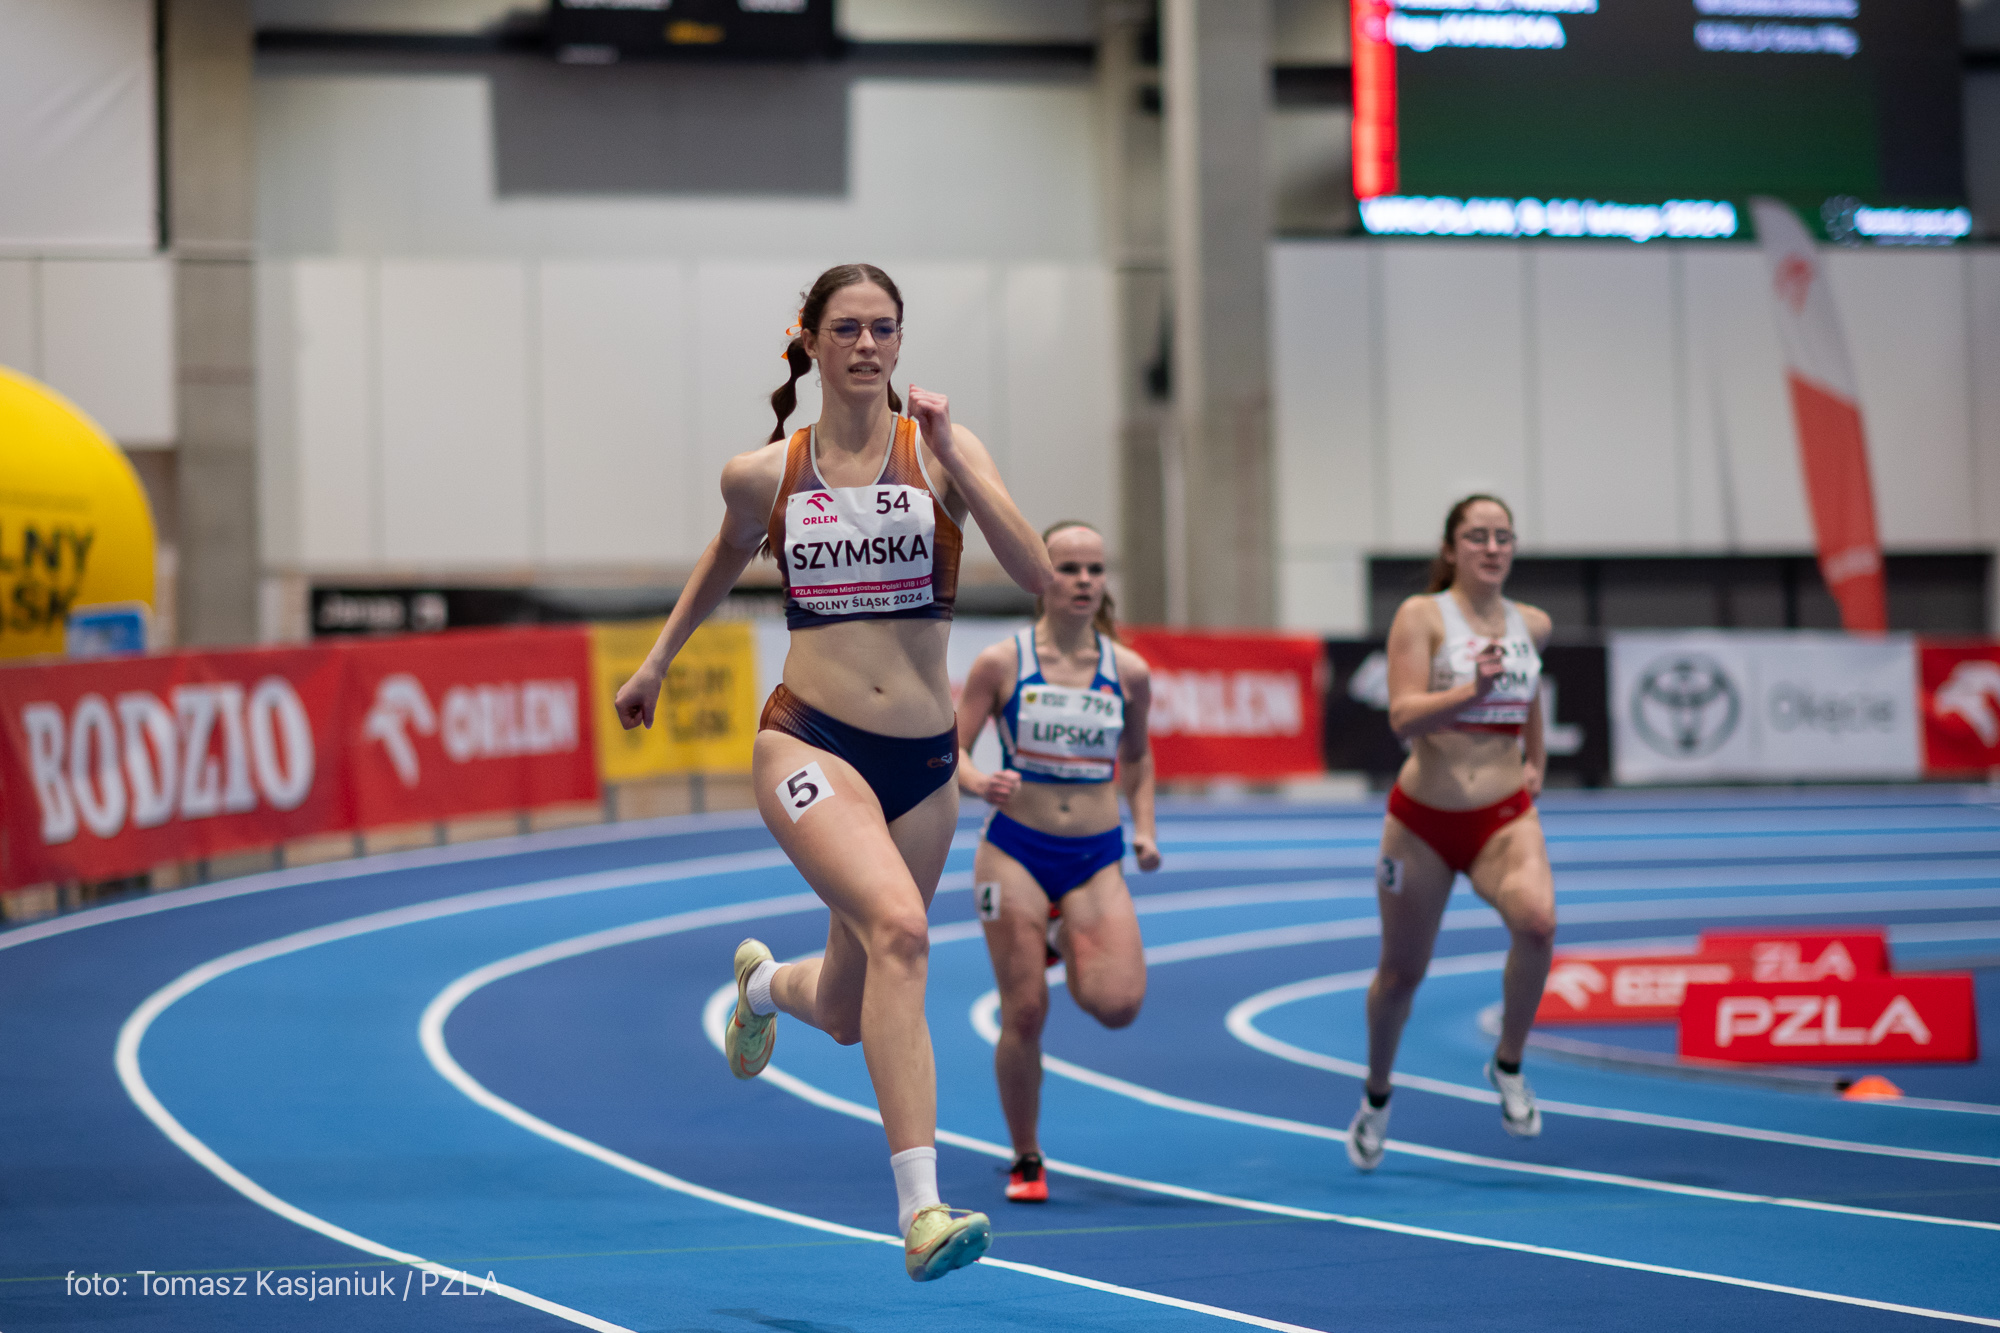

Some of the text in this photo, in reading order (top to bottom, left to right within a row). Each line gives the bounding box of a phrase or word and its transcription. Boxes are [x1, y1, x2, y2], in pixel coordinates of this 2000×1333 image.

[876, 491, 911, 514] 54
[803, 515, 838, 525] ORLEN
[792, 534, 929, 570] SZYMSKA
[795, 588, 812, 596] PZLA
[813, 587, 839, 595] Halowe
[839, 585, 881, 594] Mistrzostwa
[882, 582, 902, 590] Polski
[807, 592, 923, 611] DOLNY ŚLĄSK 2024
[1081, 695, 1115, 716] 796
[438, 679, 581, 764] ORLEN
[1032, 722, 1105, 747] LIPSKA
[20, 674, 315, 845] BODZIO
[786, 770, 819, 808] 5
[981, 886, 993, 916] 4
[1714, 994, 1933, 1047] PZLA
